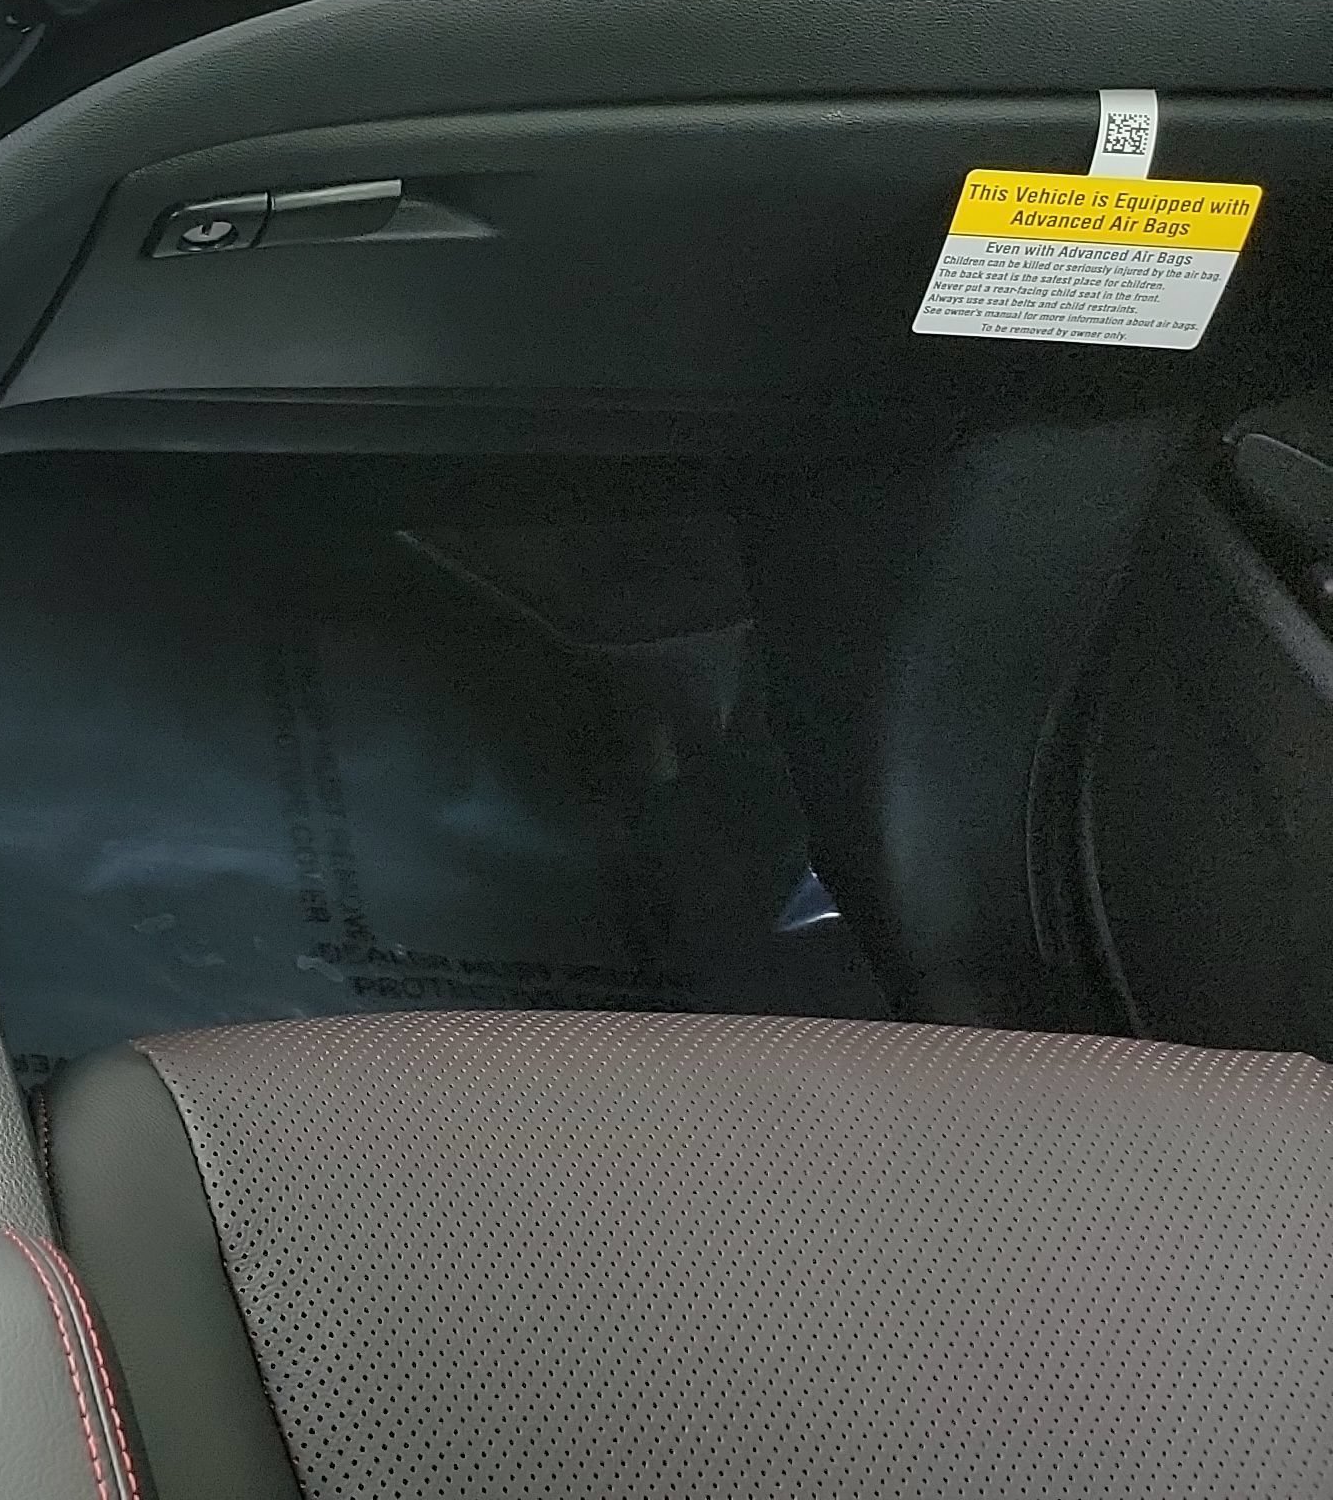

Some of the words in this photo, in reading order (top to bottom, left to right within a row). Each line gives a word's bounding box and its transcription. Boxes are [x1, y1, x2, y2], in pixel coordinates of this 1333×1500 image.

[969, 183, 1009, 202] This
[1015, 186, 1086, 207] Vehicle
[1092, 192, 1107, 208] is
[1114, 193, 1206, 216] Equipped
[1209, 198, 1250, 216] with
[1010, 210, 1105, 232] Advanced
[1109, 215, 1139, 233] Air
[1143, 217, 1191, 238] Bags
[985, 242, 1020, 255] Even
[1024, 243, 1055, 258] with
[1057, 246, 1129, 262] Advanced
[1130, 250, 1153, 264] Air
[1155, 251, 1193, 266] Bags
[943, 255, 985, 267] Children
[987, 259, 1005, 268] can
[1007, 259, 1020, 269] be
[1022, 259, 1051, 271] killed
[1053, 263, 1066, 271] or
[1065, 264, 1112, 275] seriously
[1113, 266, 1149, 277] injured
[1151, 268, 1164, 279] by
[1166, 269, 1182, 279] the
[1184, 272, 1199, 280] air
[1200, 271, 1221, 281] bag.
[981, 324, 992, 332] To
[995, 324, 1007, 333] be
[1010, 325, 1056, 335] removed
[1058, 327, 1068, 337] by
[1104, 330, 1127, 340] only.
